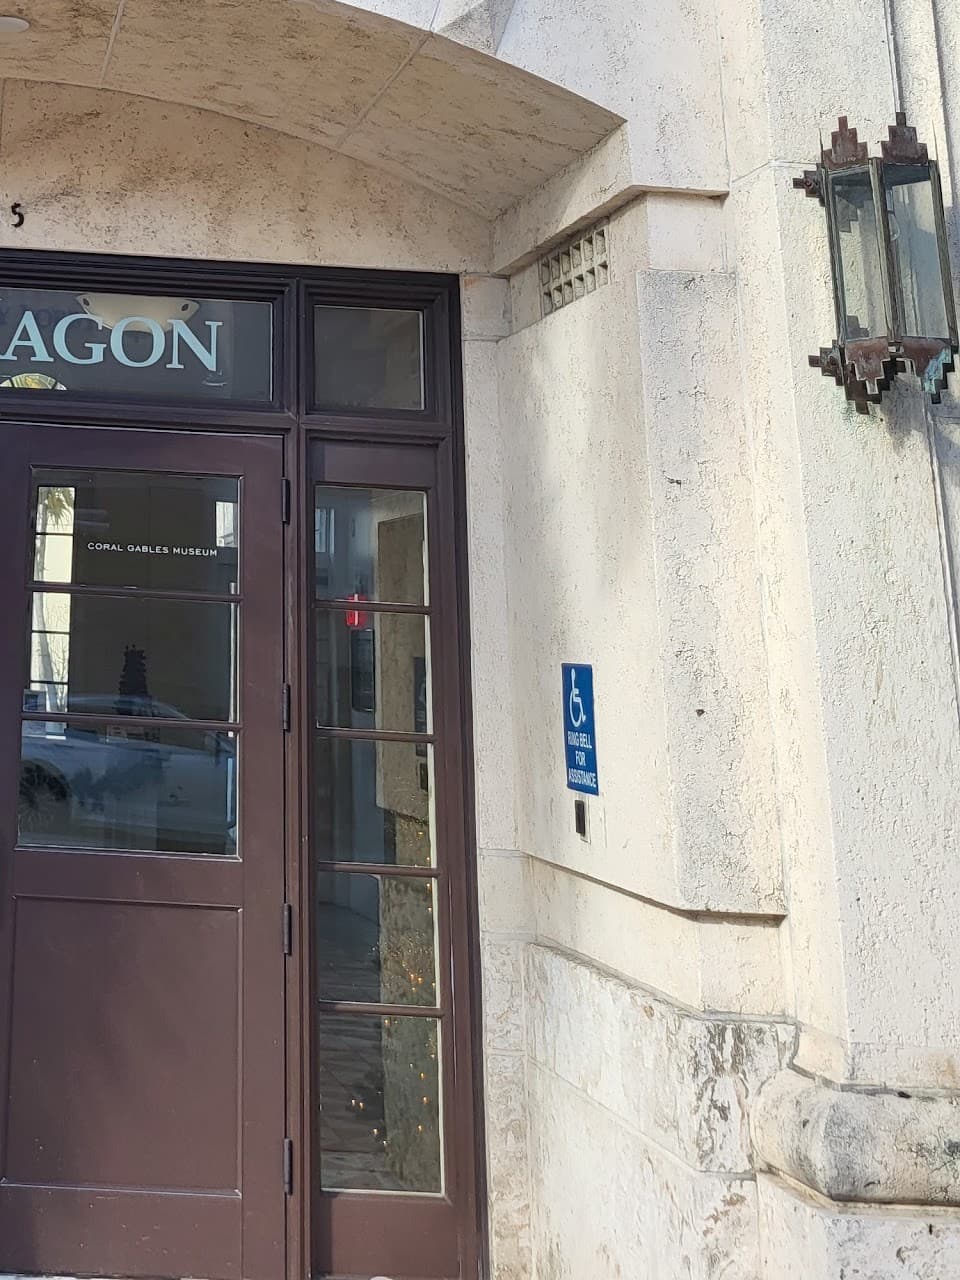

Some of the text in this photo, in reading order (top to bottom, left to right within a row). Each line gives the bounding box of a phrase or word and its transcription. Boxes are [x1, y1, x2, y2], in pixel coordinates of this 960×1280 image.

[87, 542, 217, 557] CORAL GABLES MUSEUM
[567, 731, 592, 749] RING BELL
[575, 750, 586, 766] FOR
[568, 768, 597, 788] ASSISTANCE
